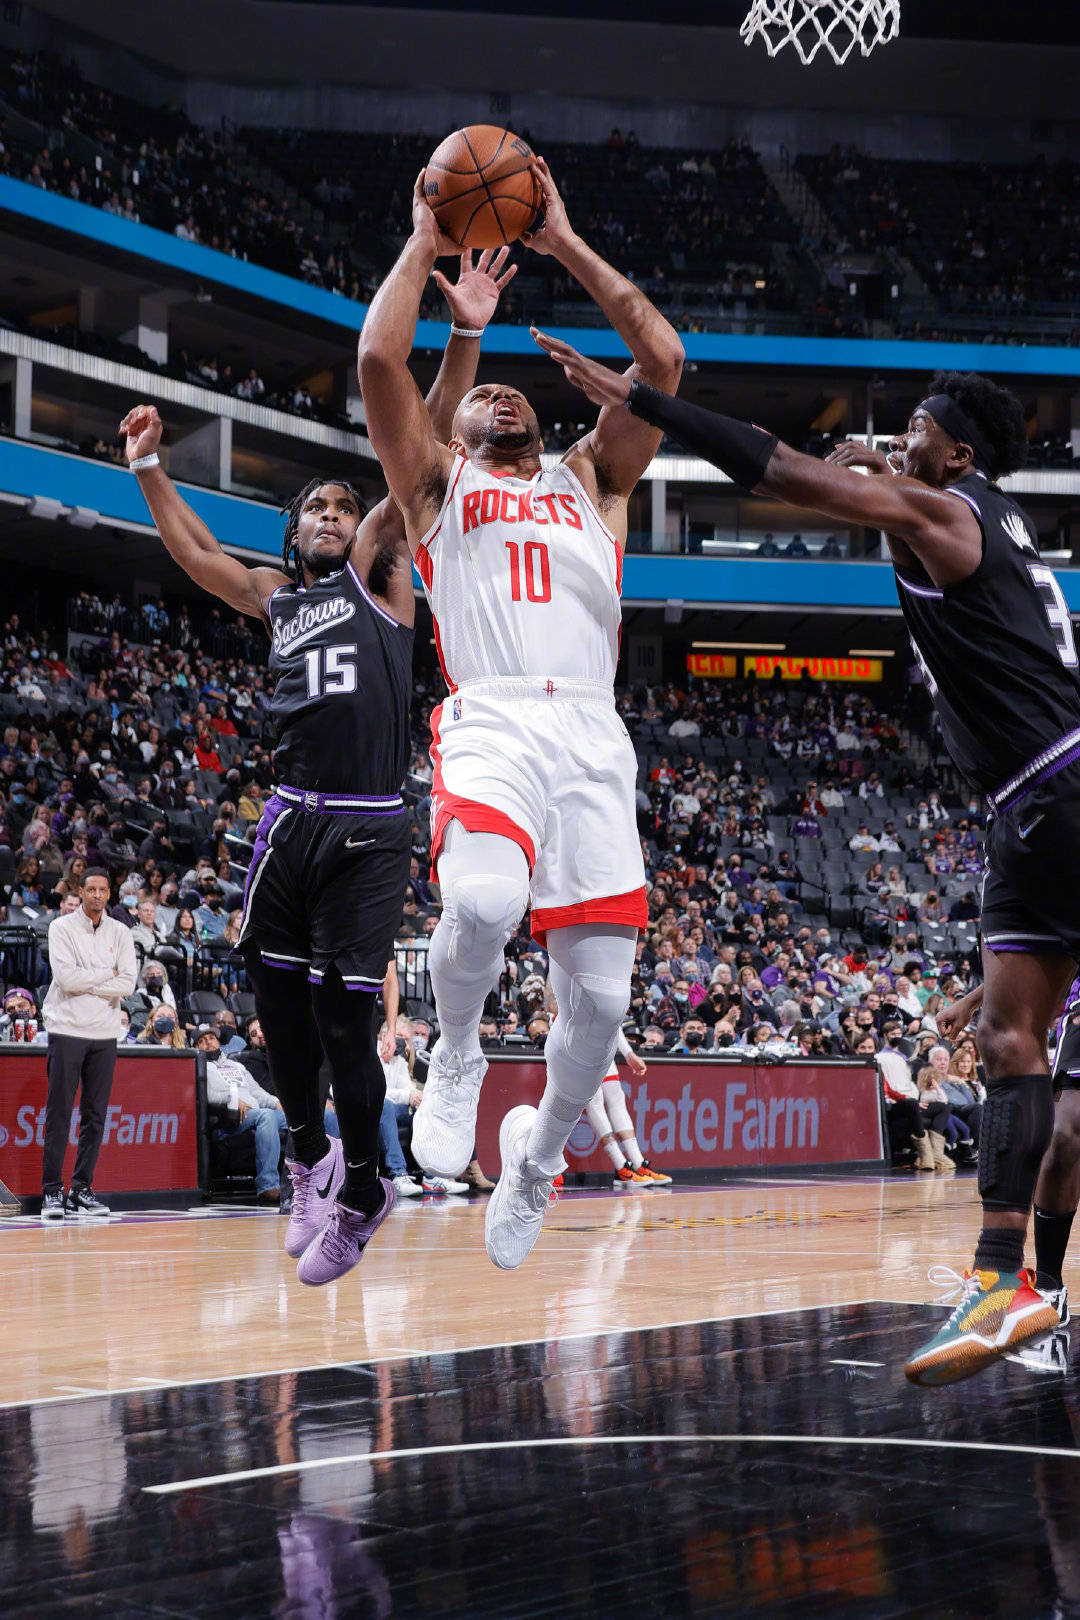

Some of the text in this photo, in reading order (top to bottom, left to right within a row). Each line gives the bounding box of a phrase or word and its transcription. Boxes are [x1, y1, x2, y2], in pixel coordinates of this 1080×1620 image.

[463, 488, 583, 535] ROCKETS
[506, 541, 552, 603] 10
[273, 596, 348, 655] Sactown
[304, 642, 358, 700] 15
[687, 654, 724, 673] ER
[14, 1105, 82, 1147] Stt
[620, 1081, 719, 1152] tate
